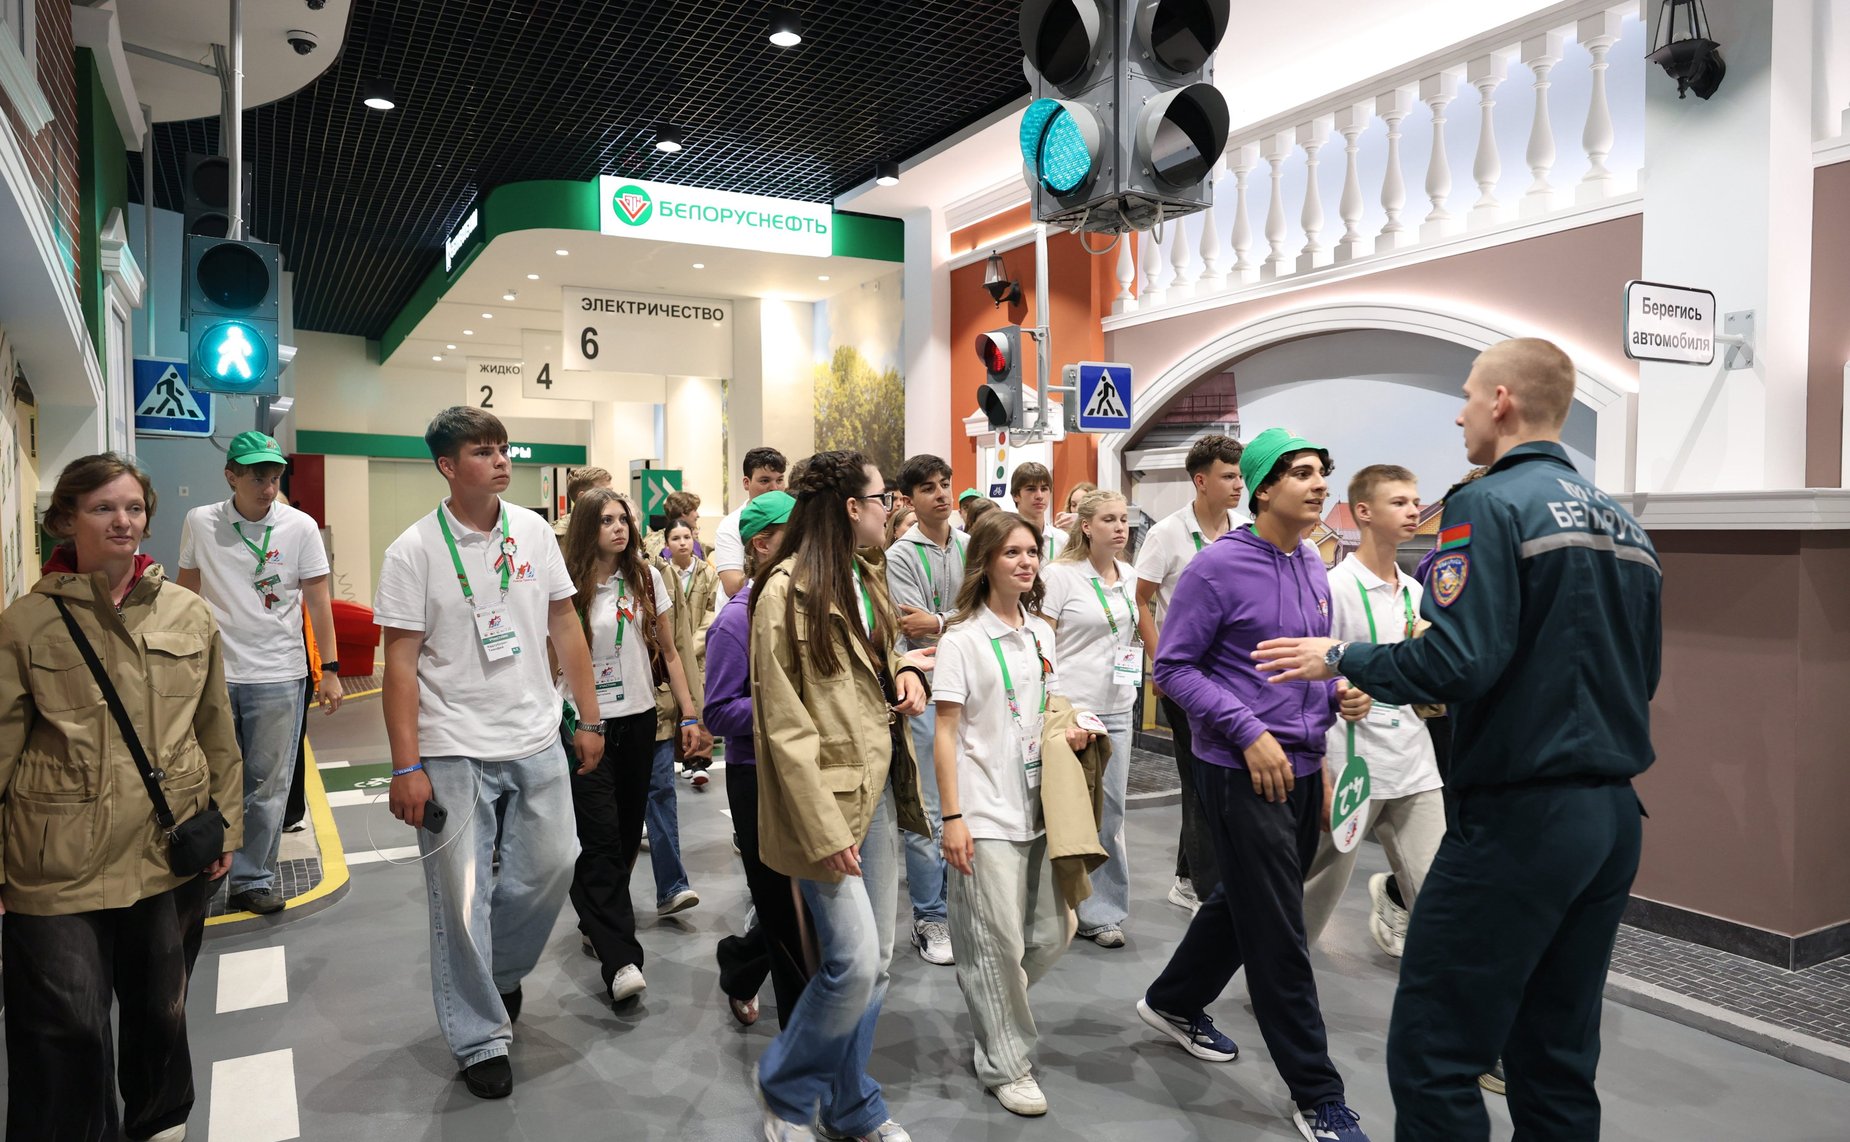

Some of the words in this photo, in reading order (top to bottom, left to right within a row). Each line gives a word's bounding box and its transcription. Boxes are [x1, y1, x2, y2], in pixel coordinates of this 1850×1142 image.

[659, 200, 828, 235] БЕЛОРУСНЕФТЬ
[581, 297, 724, 321] ЭЛЕКТРИЧЕСТВО
[1642, 297, 1702, 321] Берегись
[580, 327, 599, 360] 6
[1632, 331, 1710, 351] автомобиля
[479, 364, 522, 375] ЖИДКО
[536, 363, 553, 390] 4
[480, 385, 494, 408] 2
